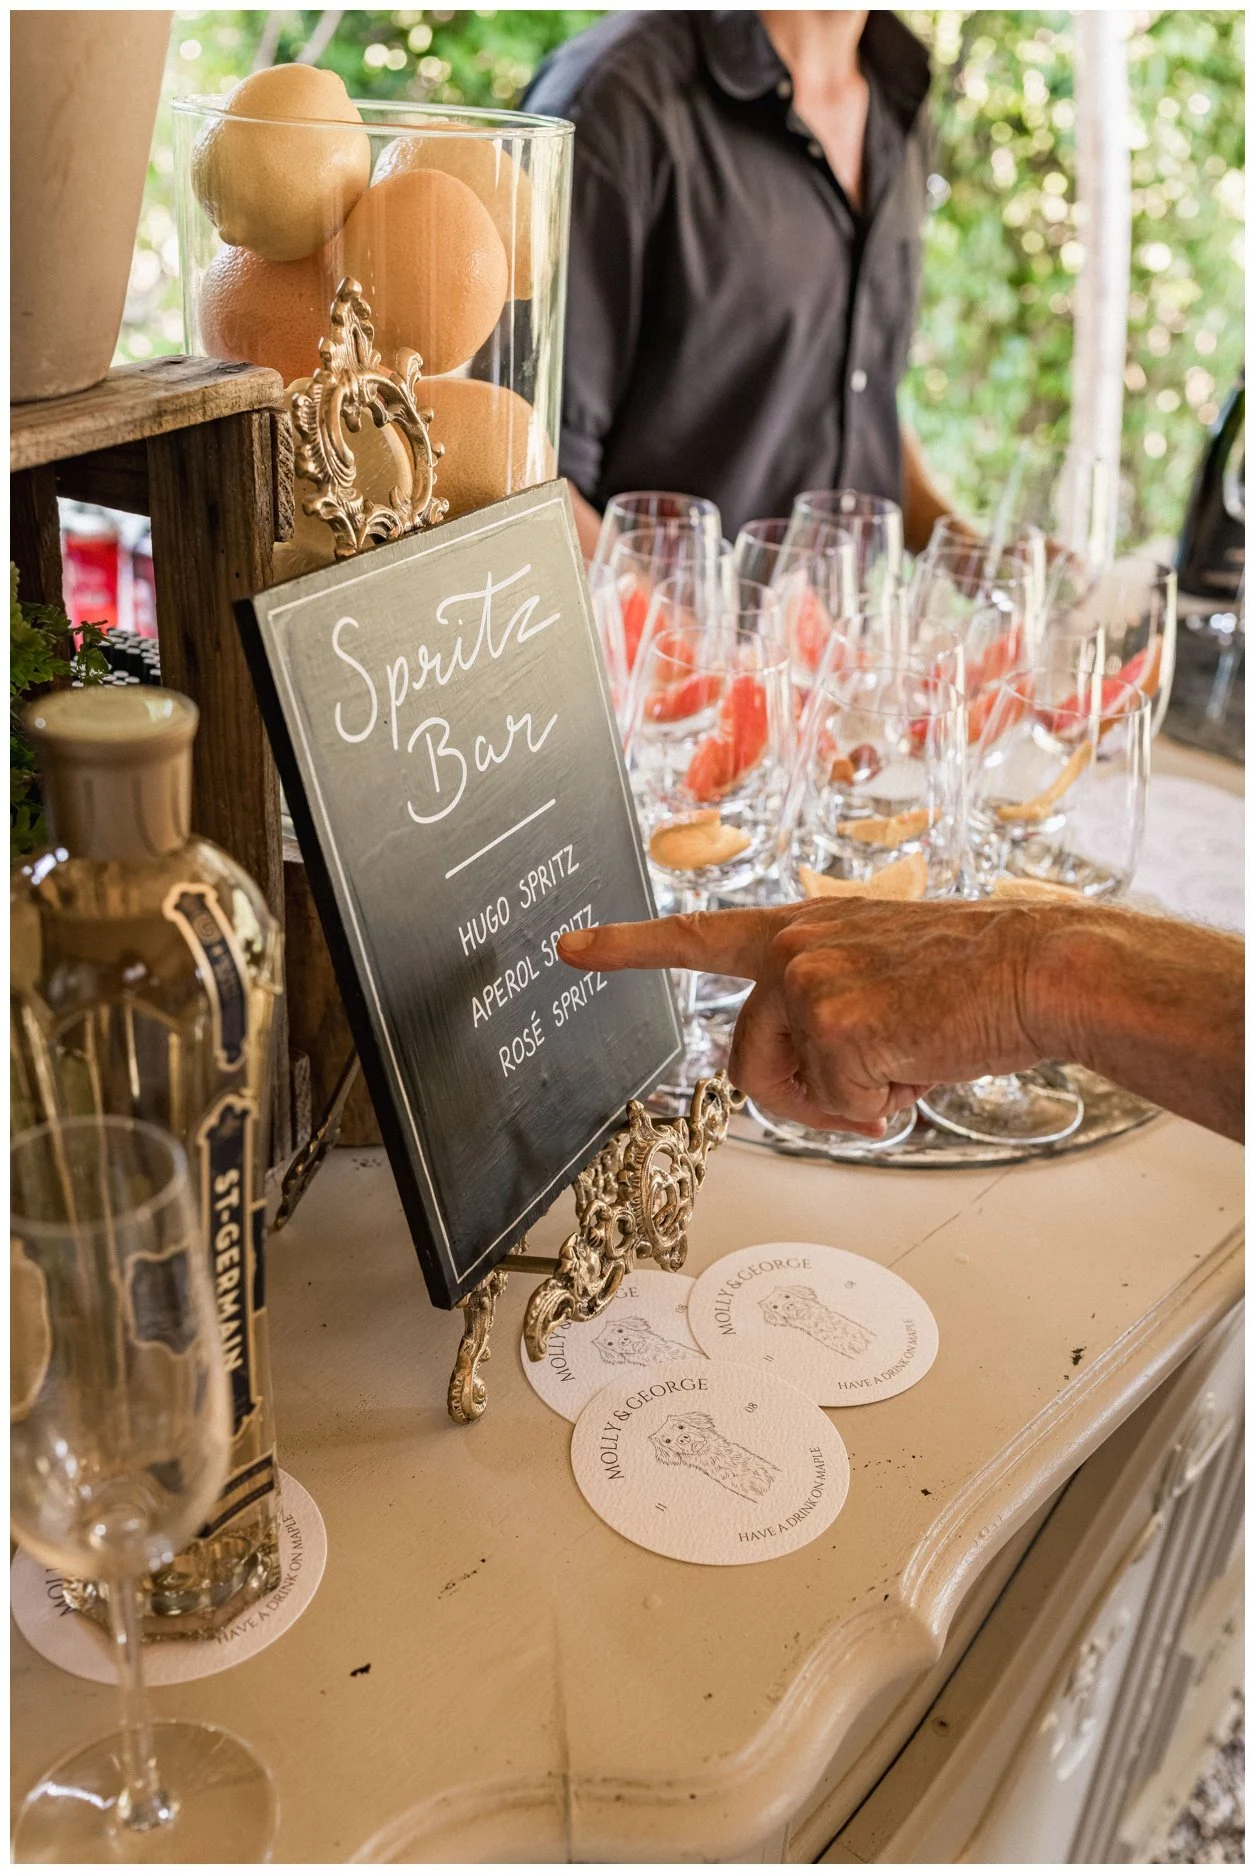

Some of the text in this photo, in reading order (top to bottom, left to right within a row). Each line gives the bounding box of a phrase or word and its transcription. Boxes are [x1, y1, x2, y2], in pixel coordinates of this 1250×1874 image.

[331, 563, 561, 750] Spritz
[407, 712, 558, 824] Bar
[458, 844, 580, 956] HUGO SPRITZ
[471, 956, 540, 1028] APEROL
[498, 971, 608, 1077] ROSÉ SPRITZ
[214, 1167, 243, 1373] ST-GERMAIN
[714, 1257, 812, 1336] MOLLY & GEORGE
[548, 1331, 576, 1382] MOLLY
[838, 1318, 918, 1391] HAVE A DRINK ON MAPLE
[600, 1377, 709, 1481] MOLLY & GEORGE
[744, 1401, 759, 1414] 08
[738, 1446, 827, 1542] HAVE A DRINK ON MAPLE
[215, 1514, 304, 1645] HAVE A DRINK ON MAPLE
